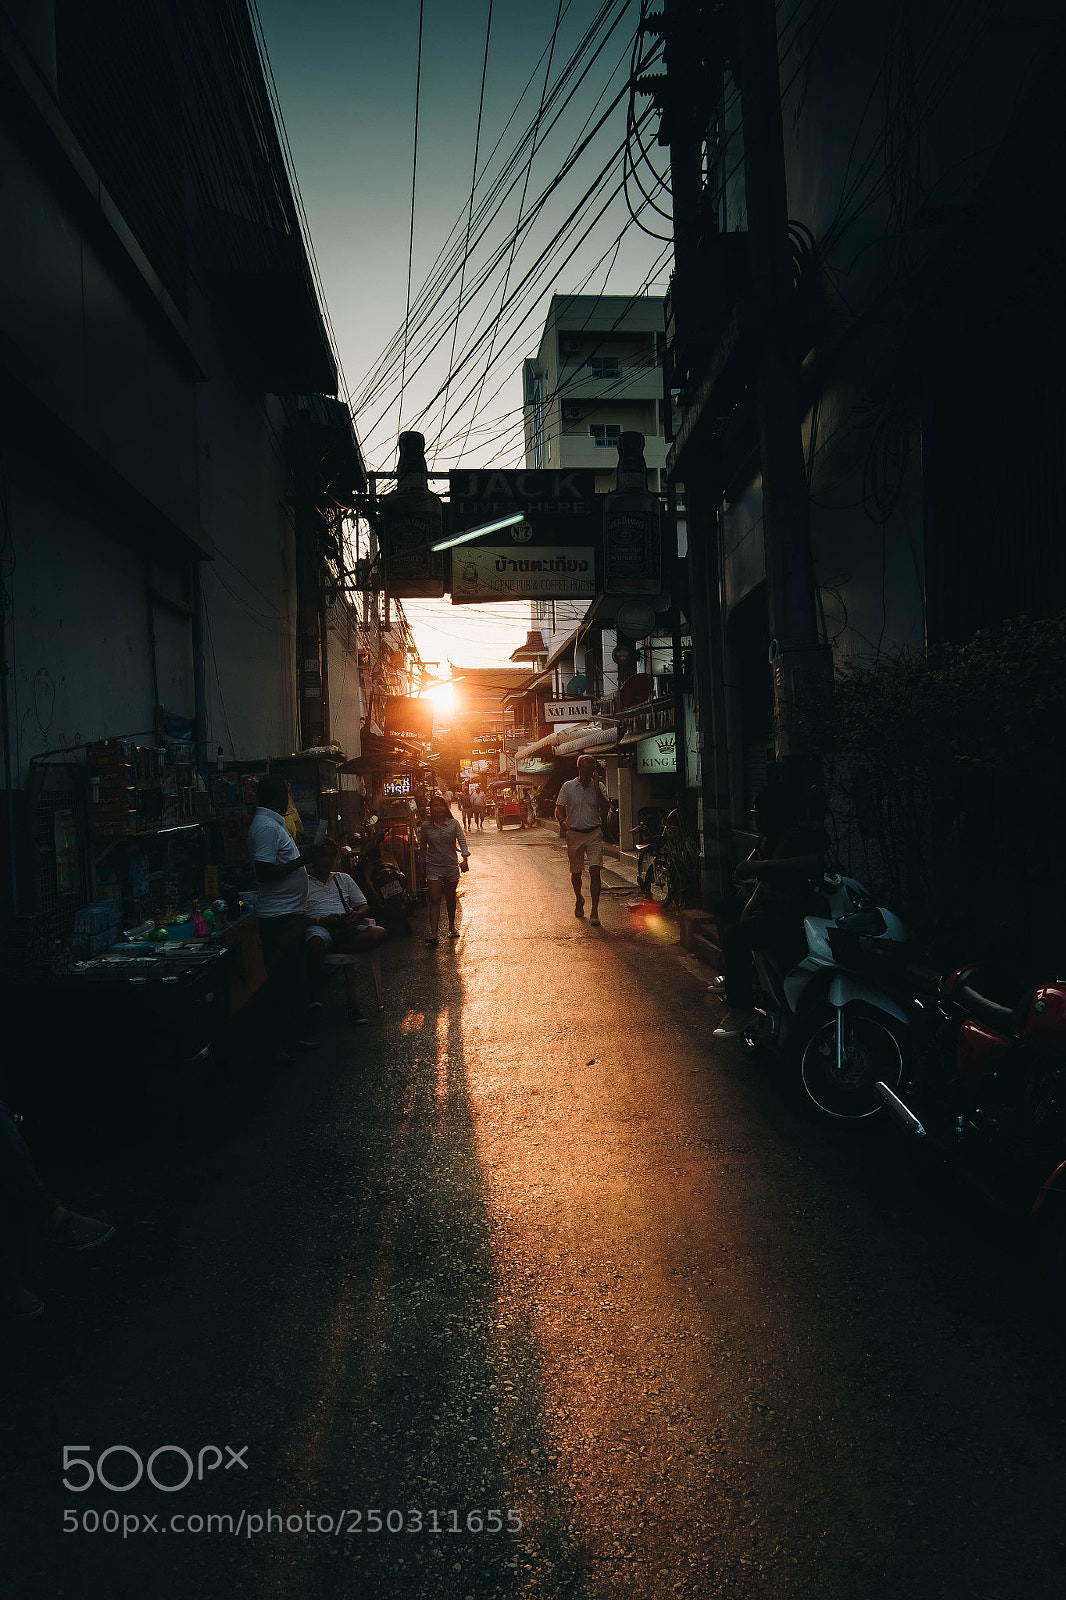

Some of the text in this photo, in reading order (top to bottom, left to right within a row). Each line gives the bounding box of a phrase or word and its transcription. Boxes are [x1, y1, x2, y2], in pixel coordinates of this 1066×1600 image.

[457, 472, 584, 499] JACK
[495, 555, 589, 572] บ้านตะเกียง
[517, 579, 531, 591] PUB
[541, 579, 568, 591] COFFEE
[568, 706, 588, 715] BAR
[642, 758, 669, 767] KING
